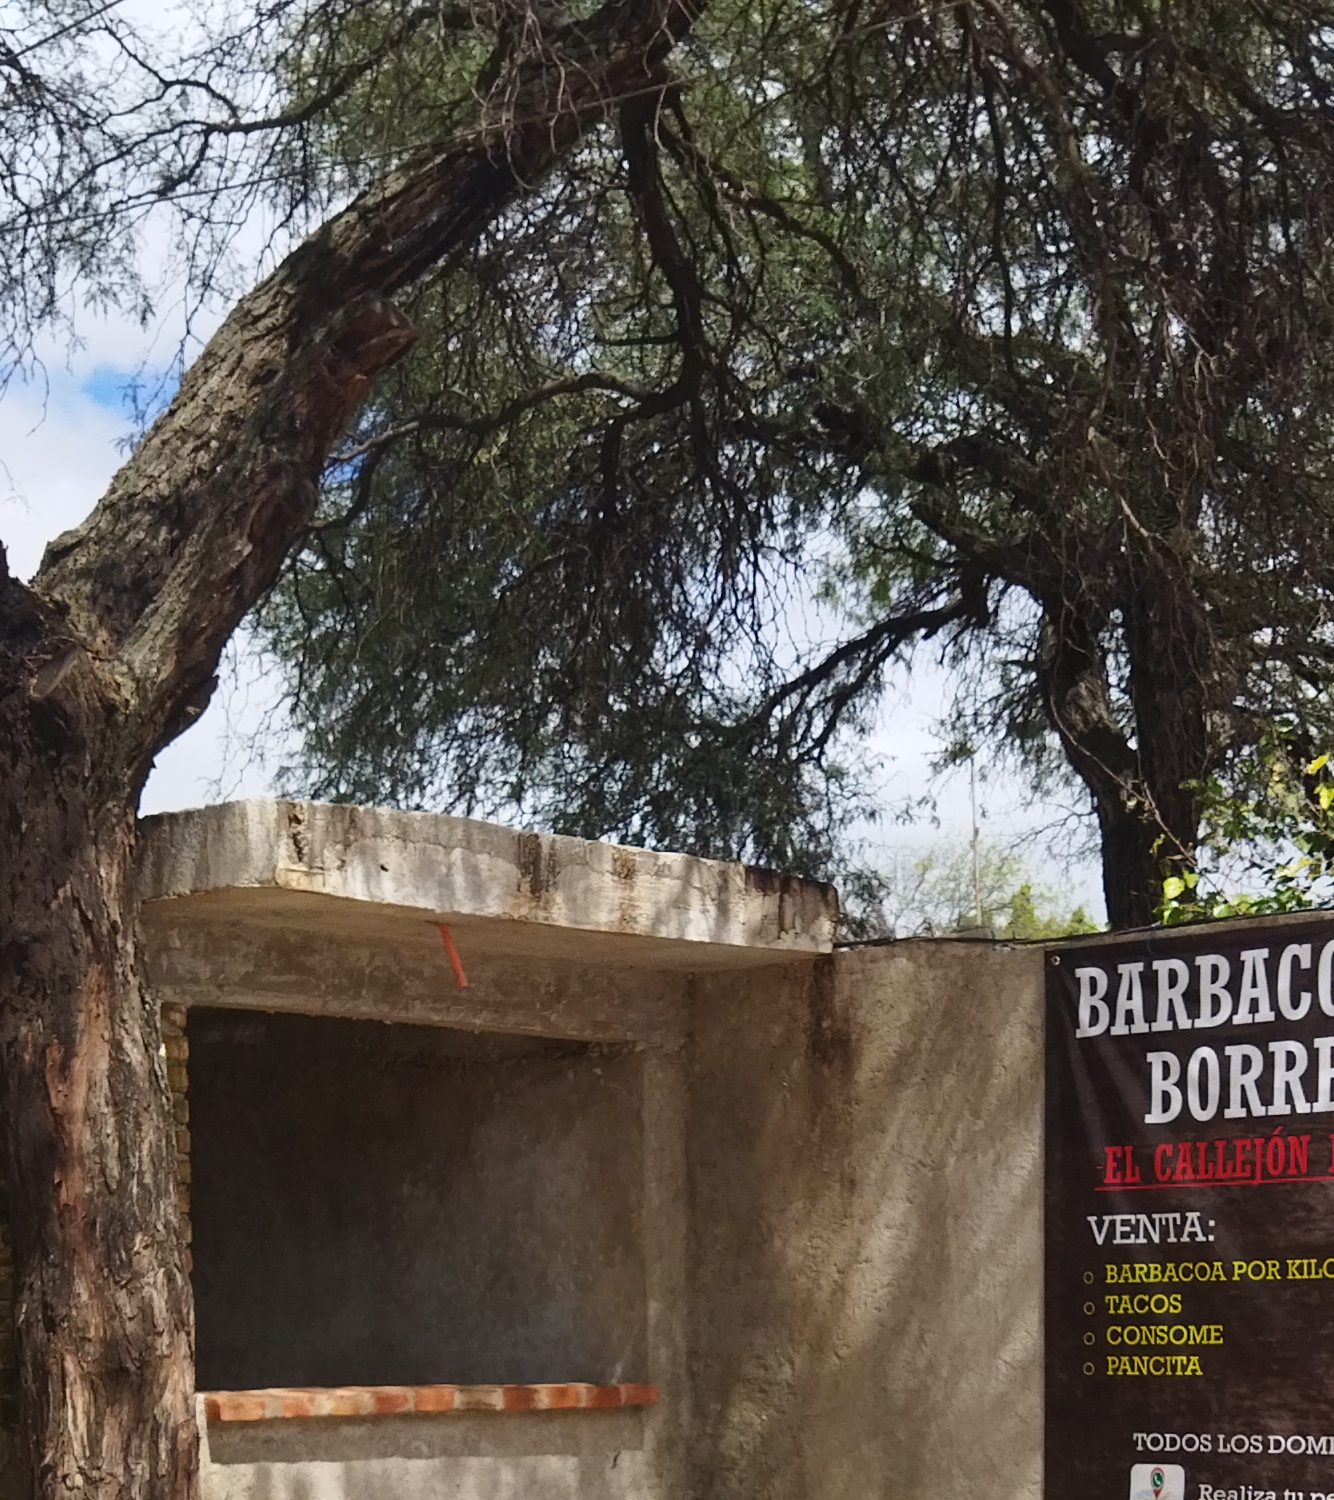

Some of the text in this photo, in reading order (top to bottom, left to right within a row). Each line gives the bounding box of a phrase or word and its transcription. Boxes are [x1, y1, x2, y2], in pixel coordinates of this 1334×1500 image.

[1103, 1146, 1141, 1184] EL
[1154, 1127, 1311, 1182] CALLEJÓN
[1086, 1212, 1216, 1246] VENTA:
[1104, 1261, 1227, 1284] BARBACOA
[1232, 1260, 1281, 1281] POR
[1104, 1294, 1183, 1315] TACOS
[1106, 1325, 1224, 1346] CONSOME
[1106, 1356, 1204, 1376] PANCITA
[1133, 1433, 1212, 1451] TODOS
[1217, 1434, 1264, 1454] LOS
